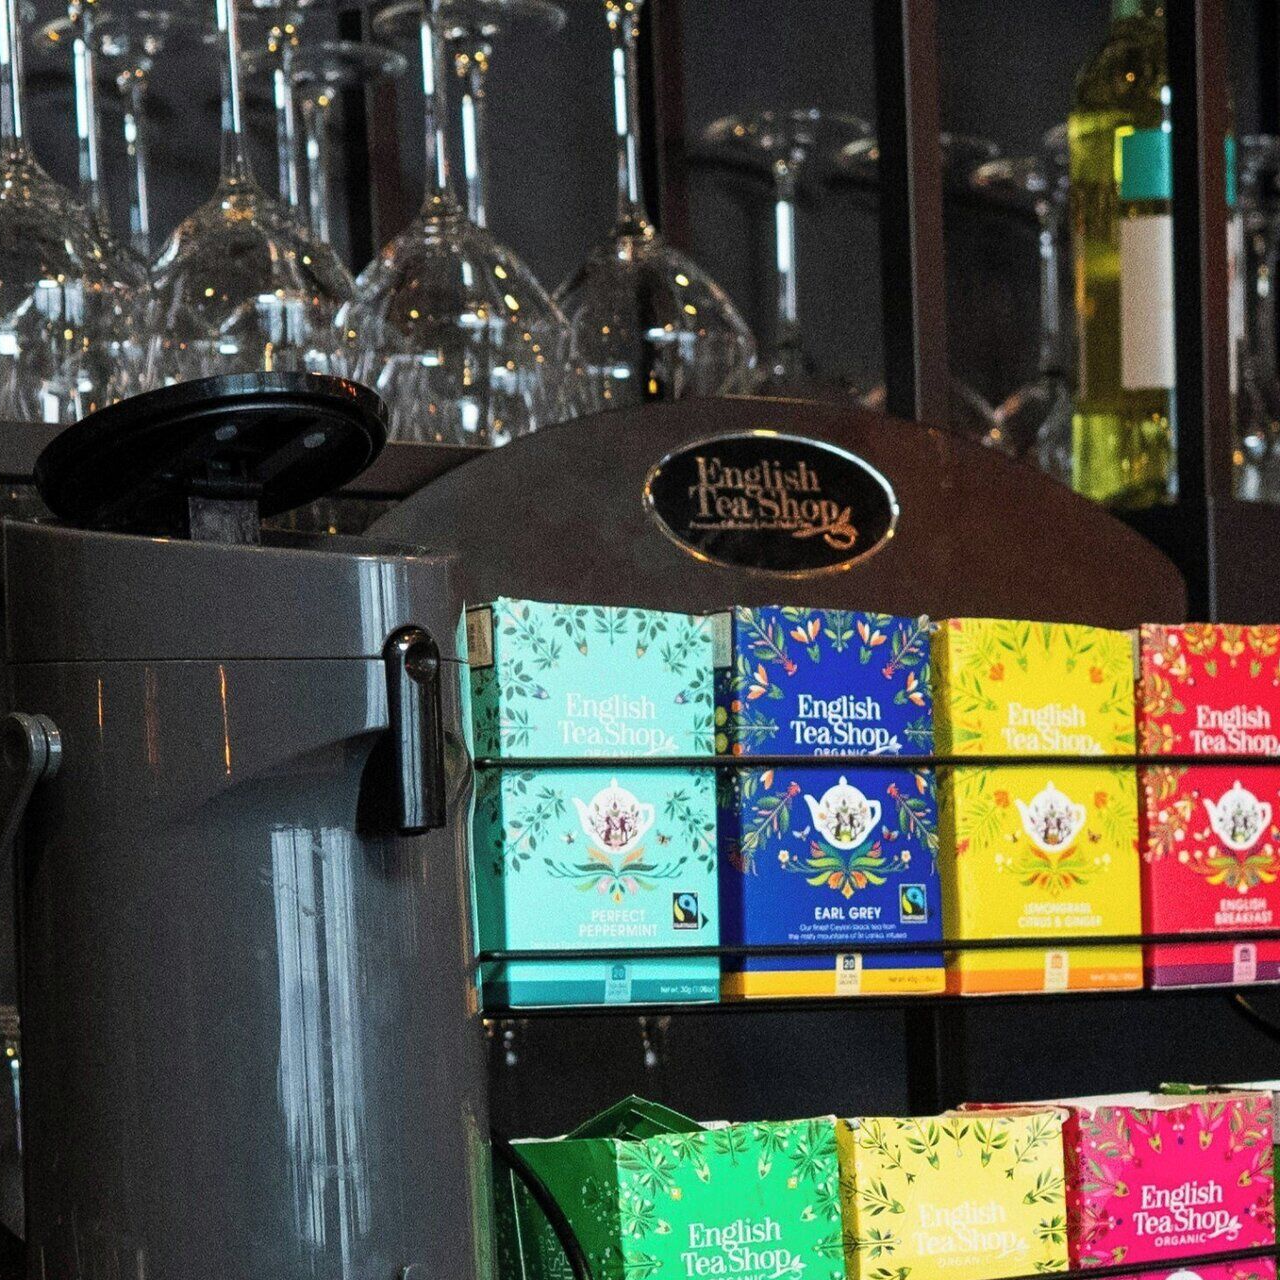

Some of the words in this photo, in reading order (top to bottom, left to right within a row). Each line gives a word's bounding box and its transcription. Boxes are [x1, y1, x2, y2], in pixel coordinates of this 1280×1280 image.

[695, 456, 820, 497] English
[567, 693, 656, 724] English
[798, 694, 881, 725] English
[1008, 702, 1086, 733] English
[1196, 705, 1270, 732] English
[591, 910, 647, 923] PERFECT
[815, 907, 845, 920] EARL
[848, 907, 881, 919] GREY
[578, 923, 658, 937] PEPPERMINT
[844, 959, 854, 969] 20
[1141, 1180, 1223, 1213] English
[920, 1201, 1006, 1236] English
[688, 1217, 782, 1253] English
[1154, 1233, 1208, 1247] ORGANIC
